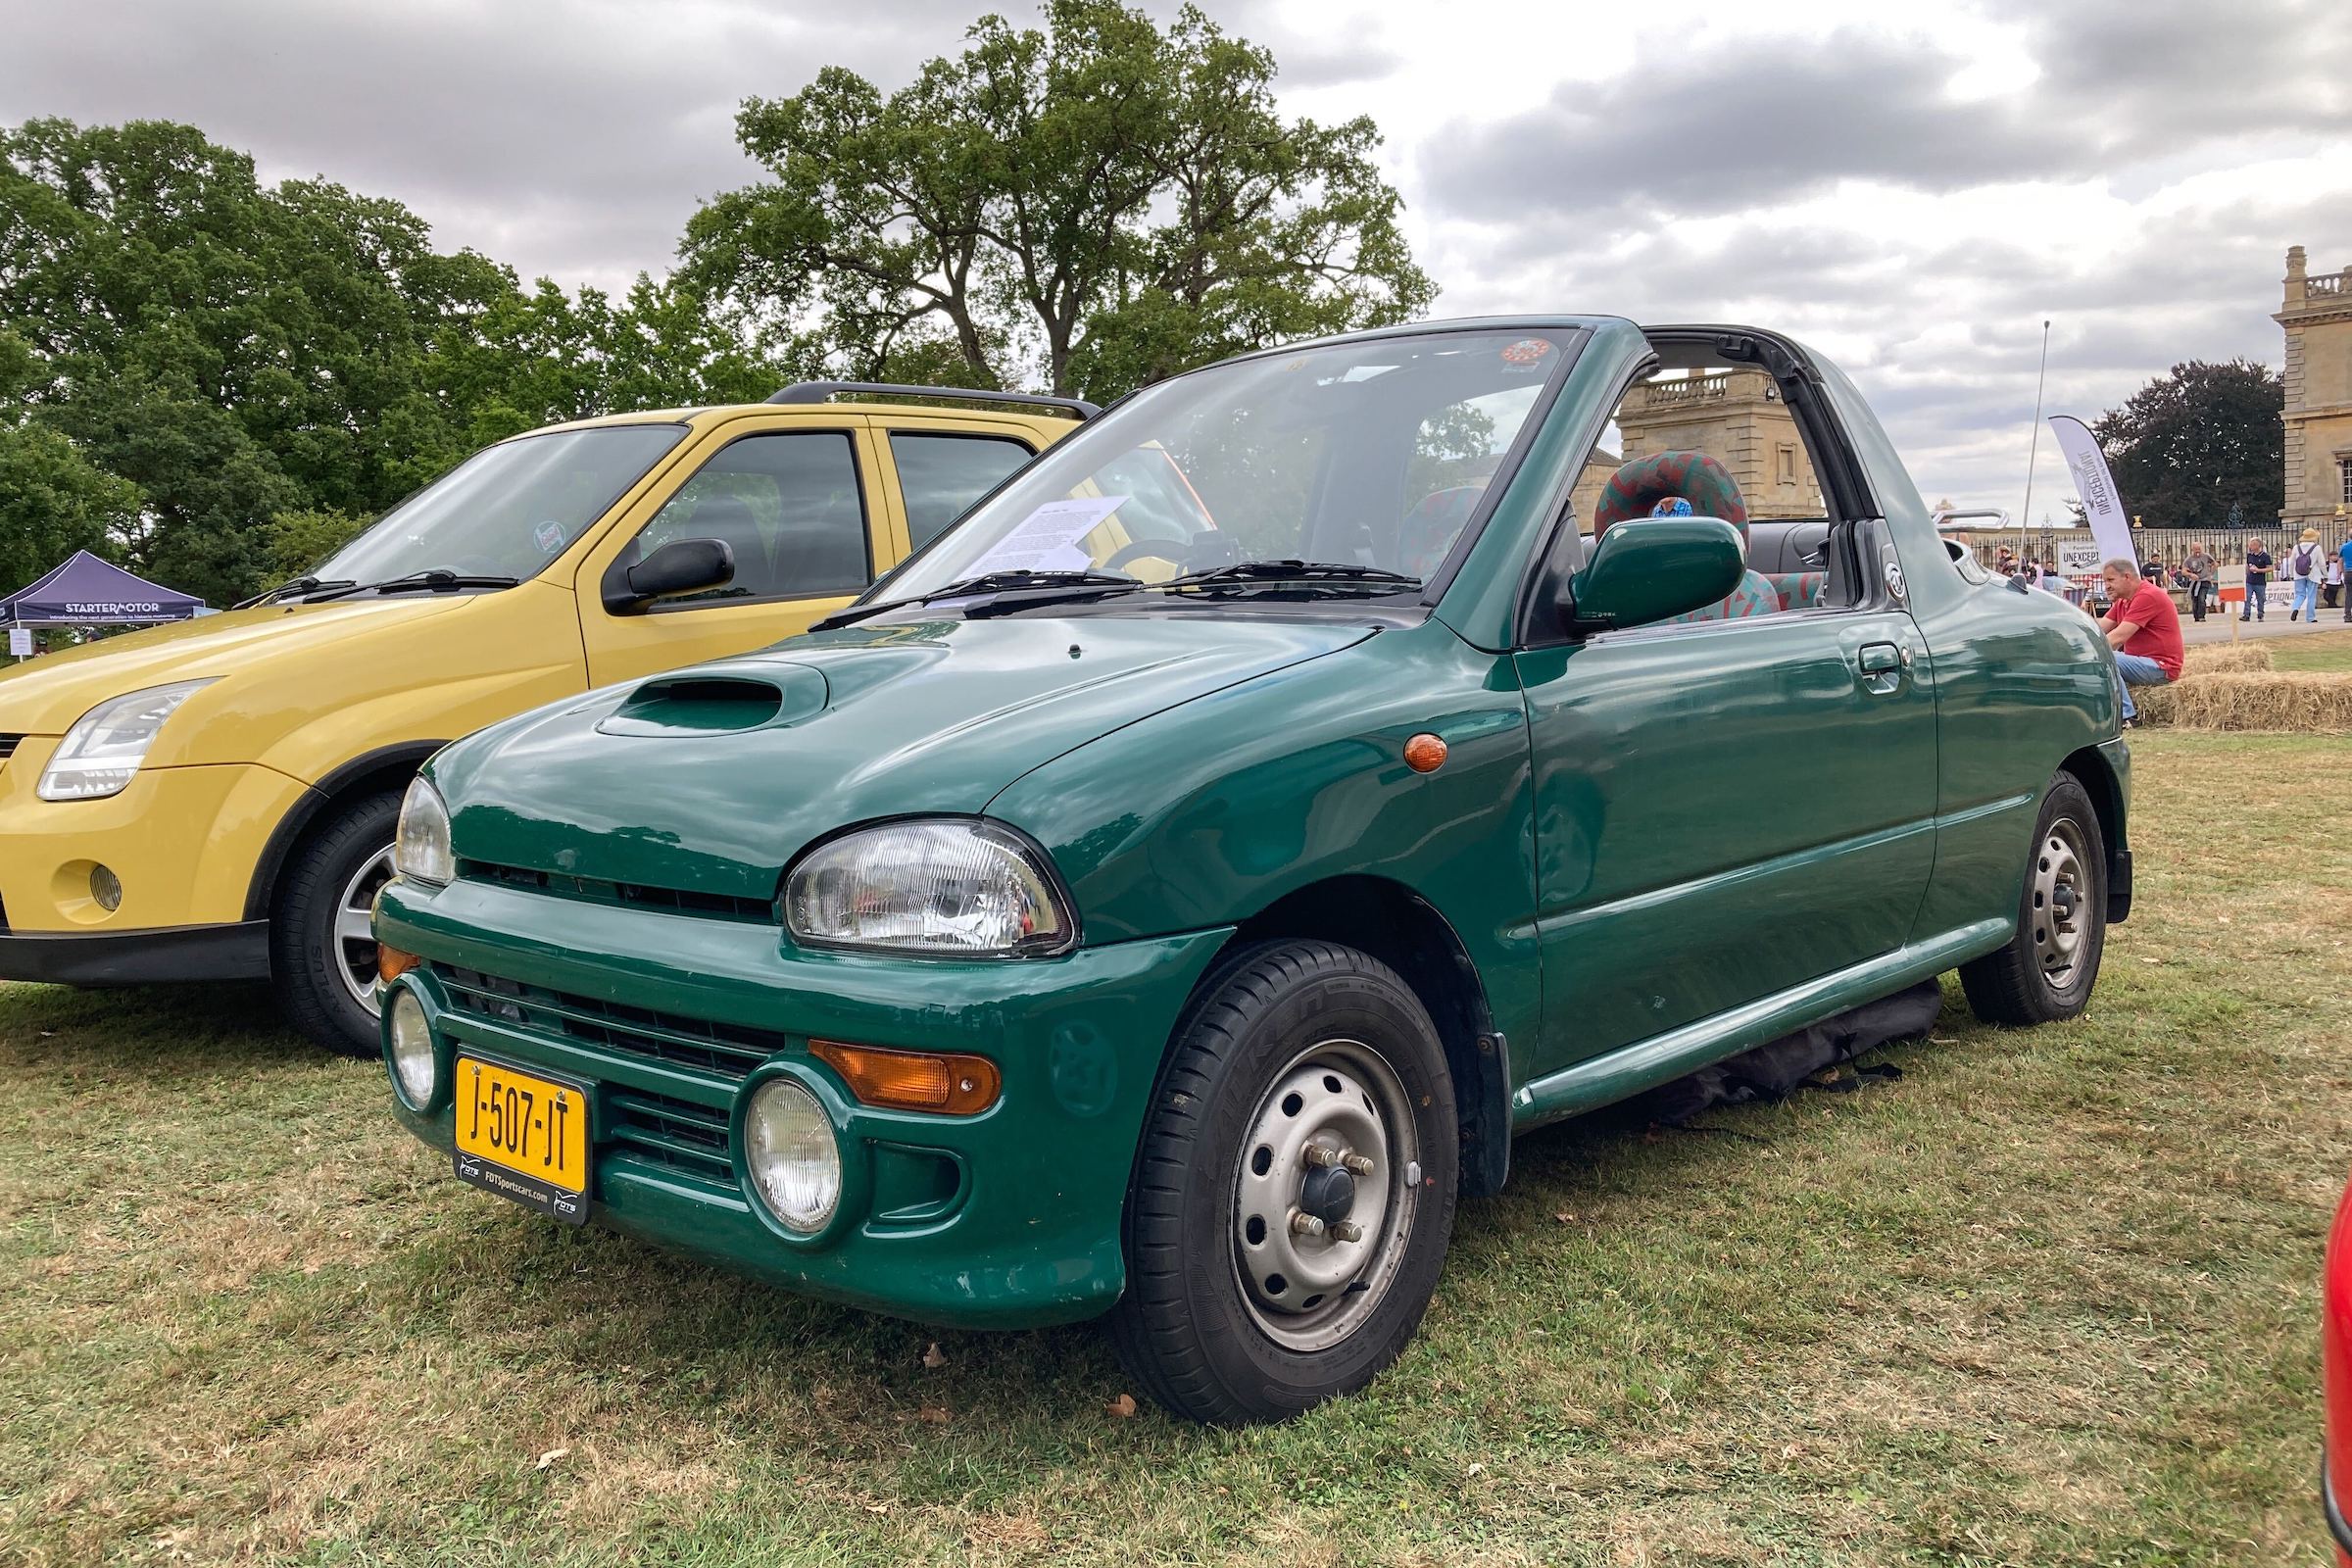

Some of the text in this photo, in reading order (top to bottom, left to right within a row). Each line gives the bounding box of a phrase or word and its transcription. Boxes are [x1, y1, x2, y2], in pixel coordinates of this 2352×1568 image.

[65, 602, 159, 614] STARTERMOTOR
[470, 1075, 568, 1171] J-507-JT
[485, 1170, 548, 1203] FDTSportscars.com
